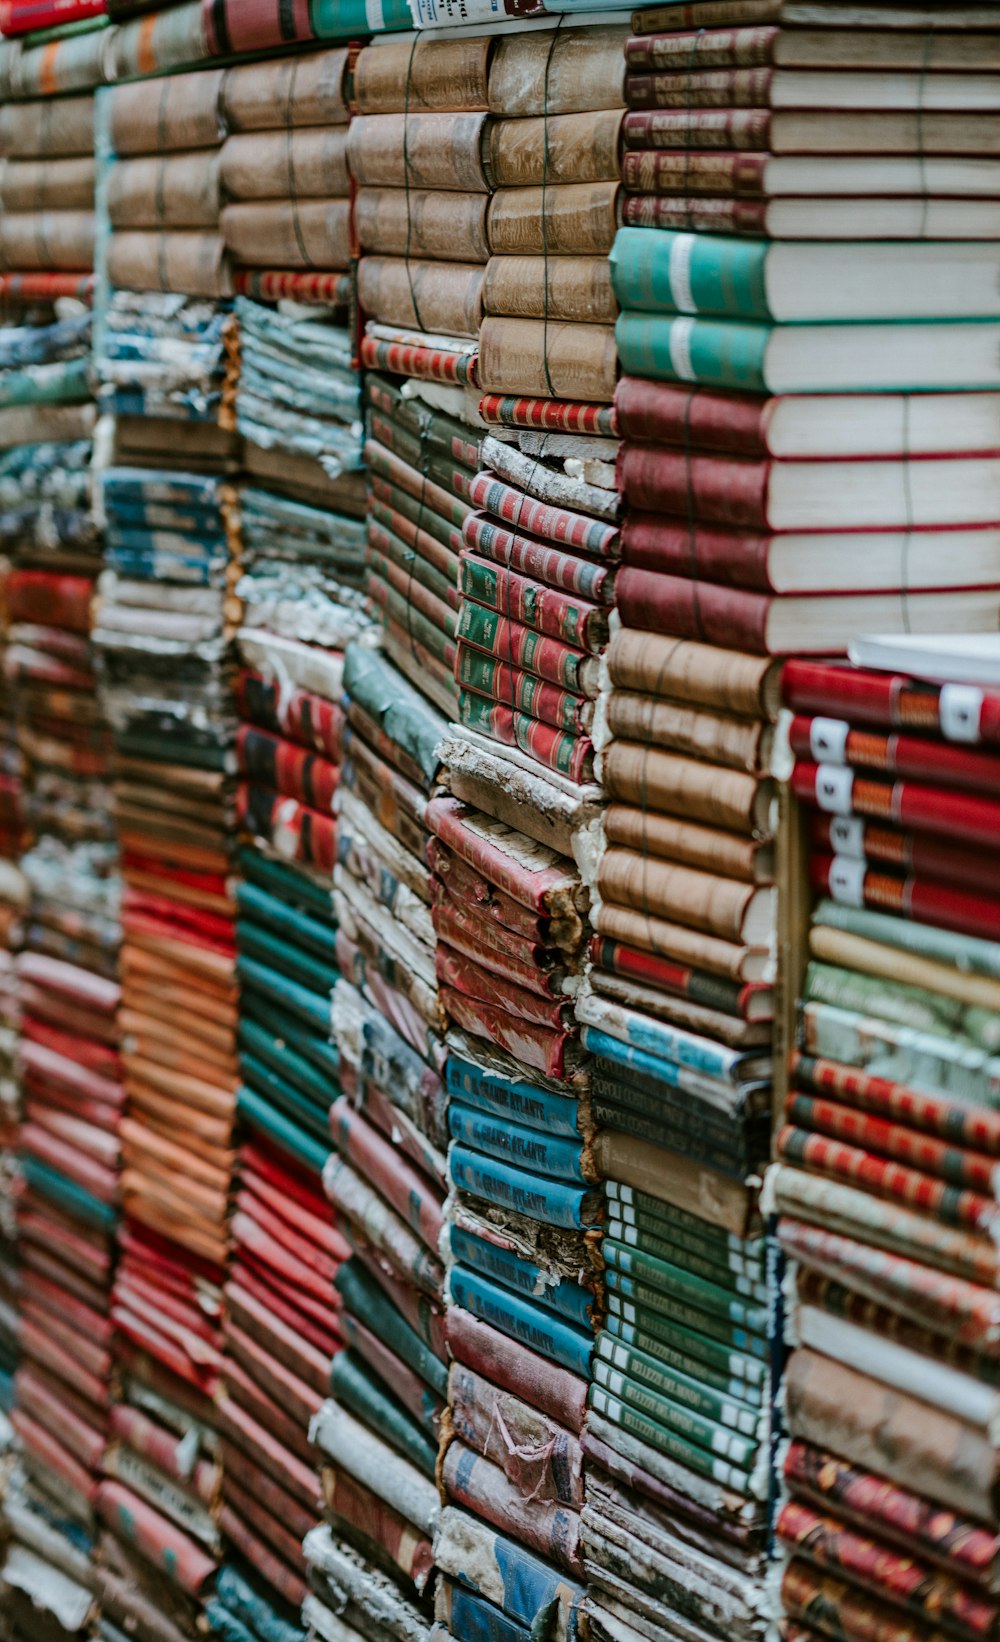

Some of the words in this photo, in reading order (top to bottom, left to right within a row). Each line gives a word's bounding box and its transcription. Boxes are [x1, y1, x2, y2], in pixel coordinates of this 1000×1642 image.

[509, 1091, 545, 1120] ATLANTE
[481, 1123, 510, 1149] GRANDE
[511, 1135, 547, 1163] ATLANTE
[512, 1185, 547, 1214] ATLANTE
[516, 1319, 556, 1355] ATLANTE
